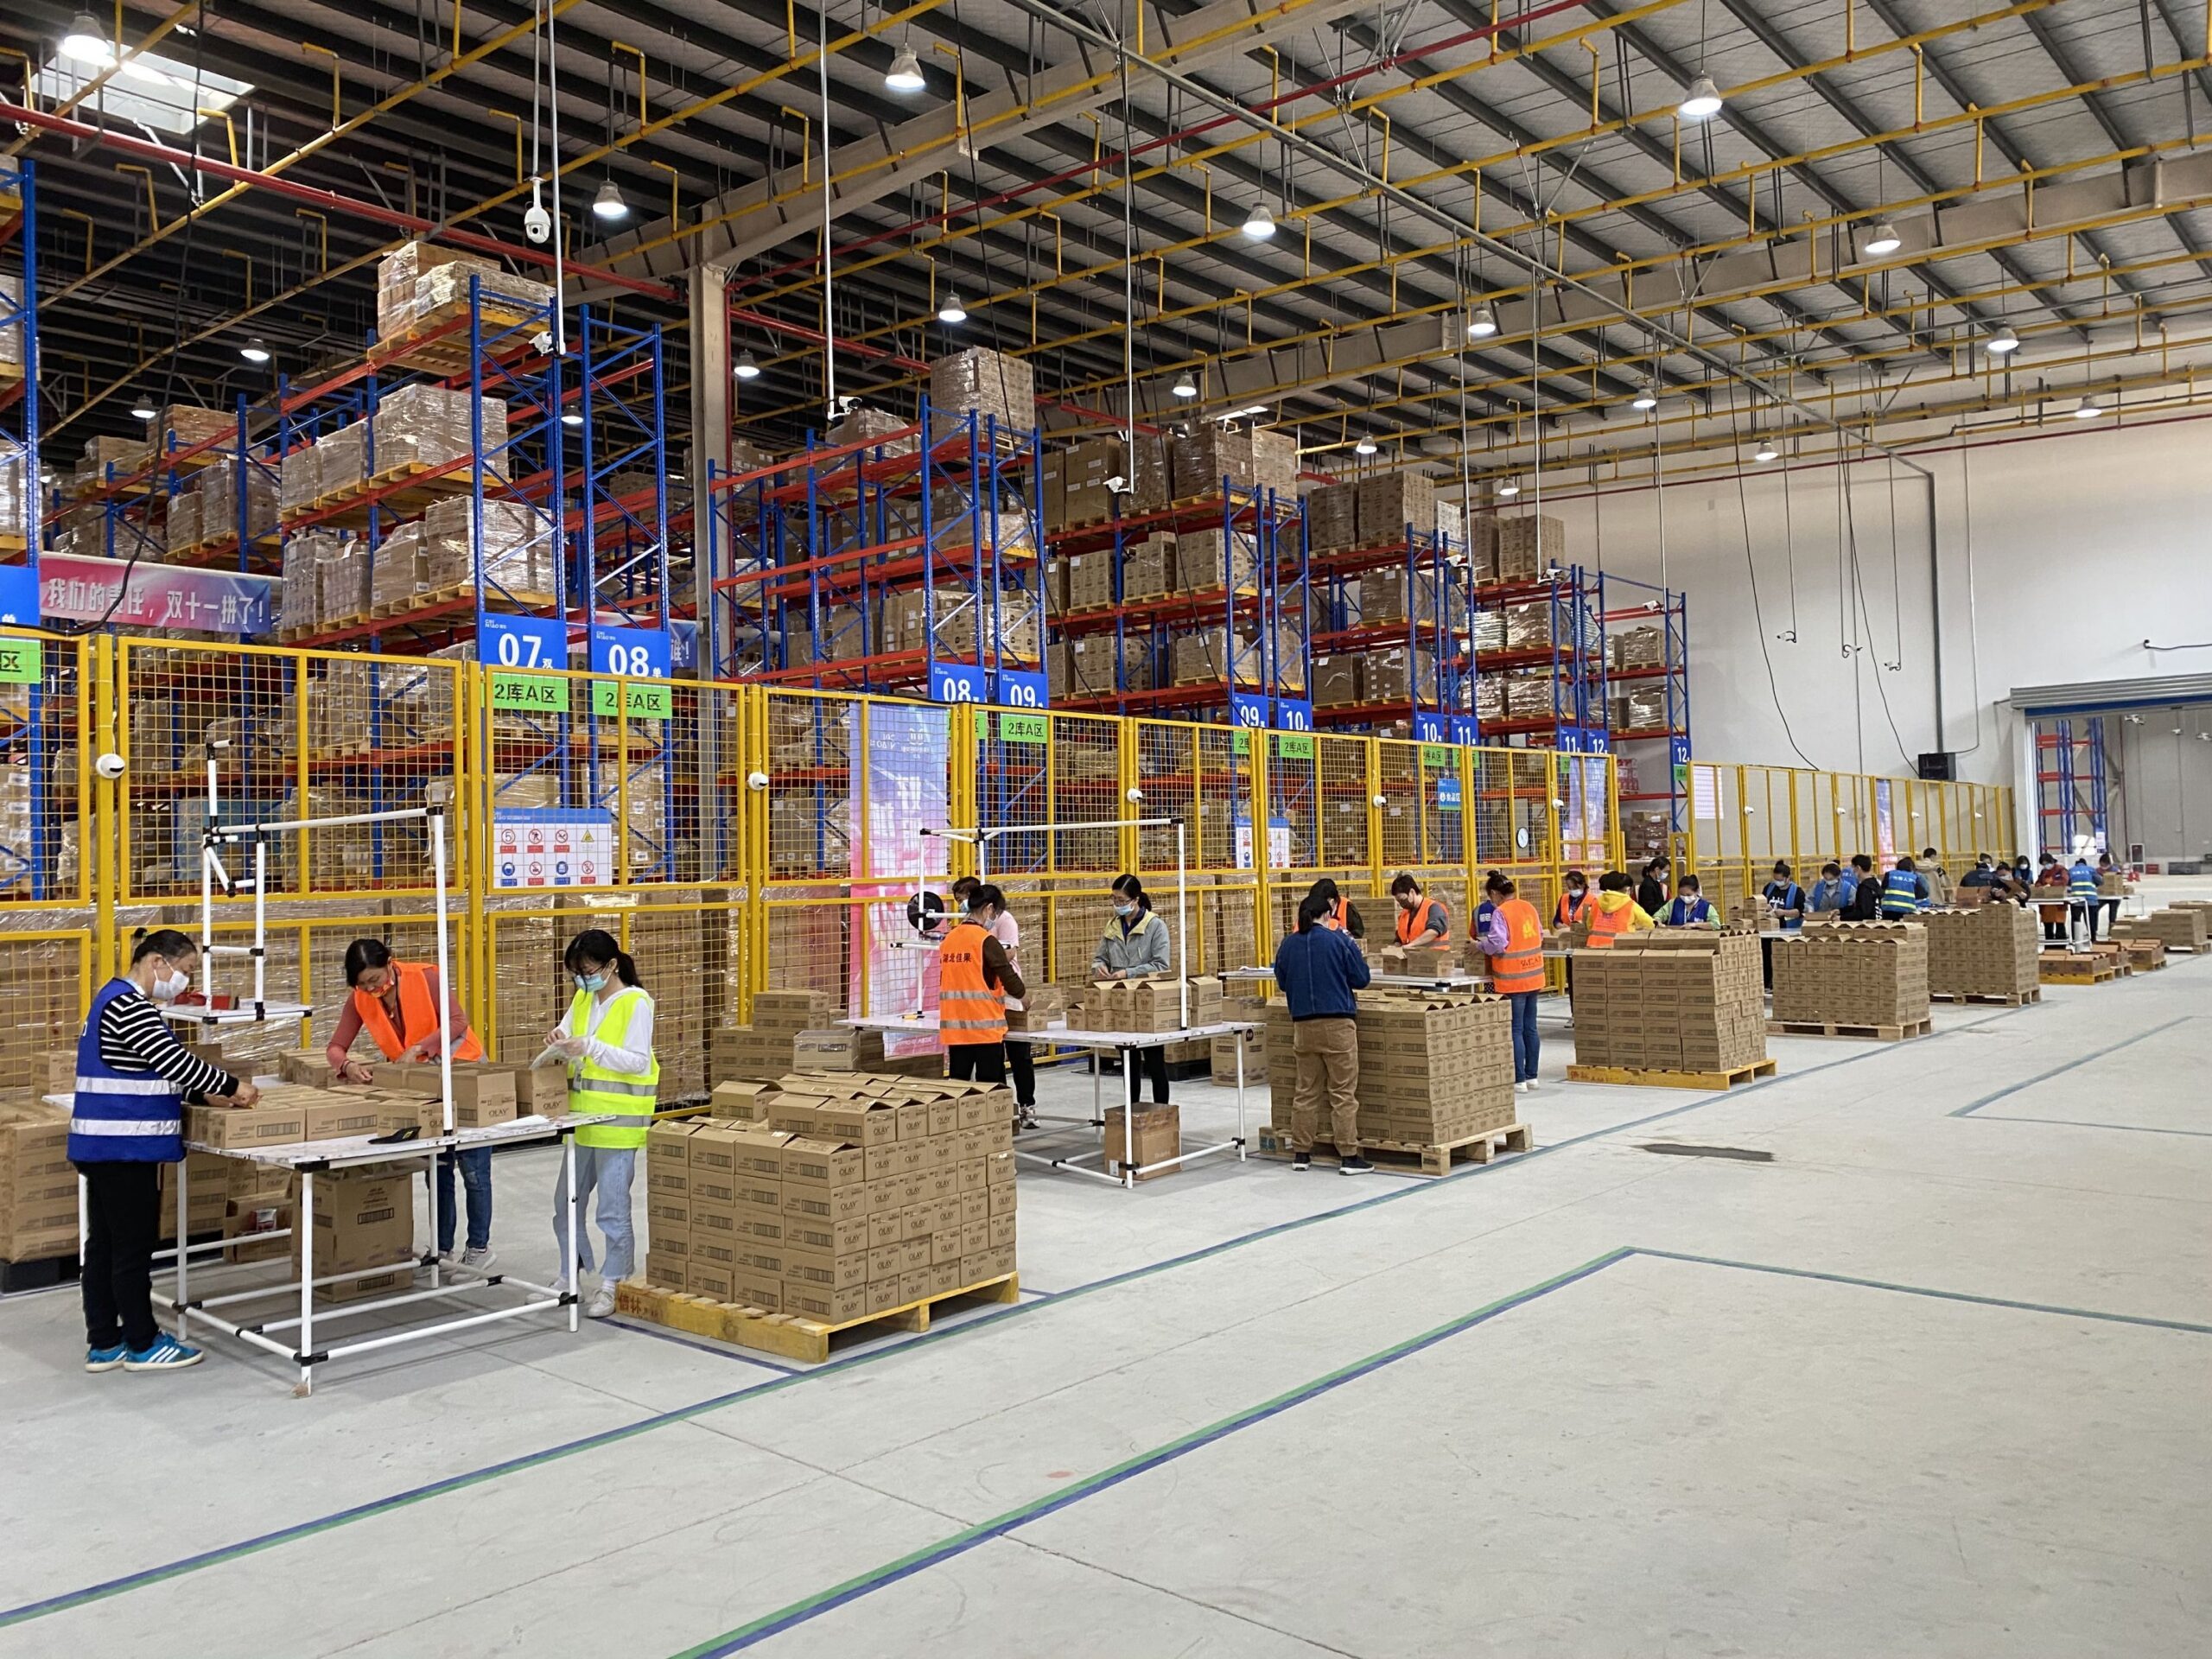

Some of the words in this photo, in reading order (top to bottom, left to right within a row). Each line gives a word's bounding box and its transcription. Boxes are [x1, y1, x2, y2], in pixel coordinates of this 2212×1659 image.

[499, 632, 542, 668] 07
[0, 650, 22, 673] 区
[609, 644, 649, 677] 08
[494, 682, 557, 704] 2库A区
[943, 677, 971, 702] 08
[1010, 684, 1036, 708] 09
[1240, 705, 1259, 728] 09
[1286, 710, 1304, 731] 10
[1008, 721, 1044, 737] 2库A区
[1422, 722, 1438, 742] 10
[1458, 726, 1471, 746] 11
[1565, 736, 1576, 753] 11
[1592, 739, 1604, 754] 12
[1677, 747, 1688, 762] 12
[543, 1101, 562, 1109] OLAY
[489, 1108, 509, 1117] OLAY
[906, 1122, 921, 1130] OLAY
[936, 1147, 950, 1156] OLAY
[906, 1154, 920, 1163] OLAY
[875, 1160, 891, 1168] OLAY
[839, 1166, 856, 1175] OLAY
[936, 1179, 950, 1189] OLAY
[906, 1186, 921, 1196] OLAY
[875, 1193, 891, 1202] OLAY
[940, 1211, 955, 1220] OLAY
[911, 1218, 926, 1228] OLAY
[879, 1226, 894, 1236] OLAY
[844, 1235, 861, 1244] OLAY
[941, 1244, 956, 1253] OLAY
[909, 1251, 924, 1260] OLAY
[877, 1260, 893, 1268] OLAY
[845, 1268, 861, 1278] OLAY
[908, 1284, 924, 1294] OLAY
[875, 1294, 892, 1302] OLAY
[842, 1302, 859, 1311] OLAY
